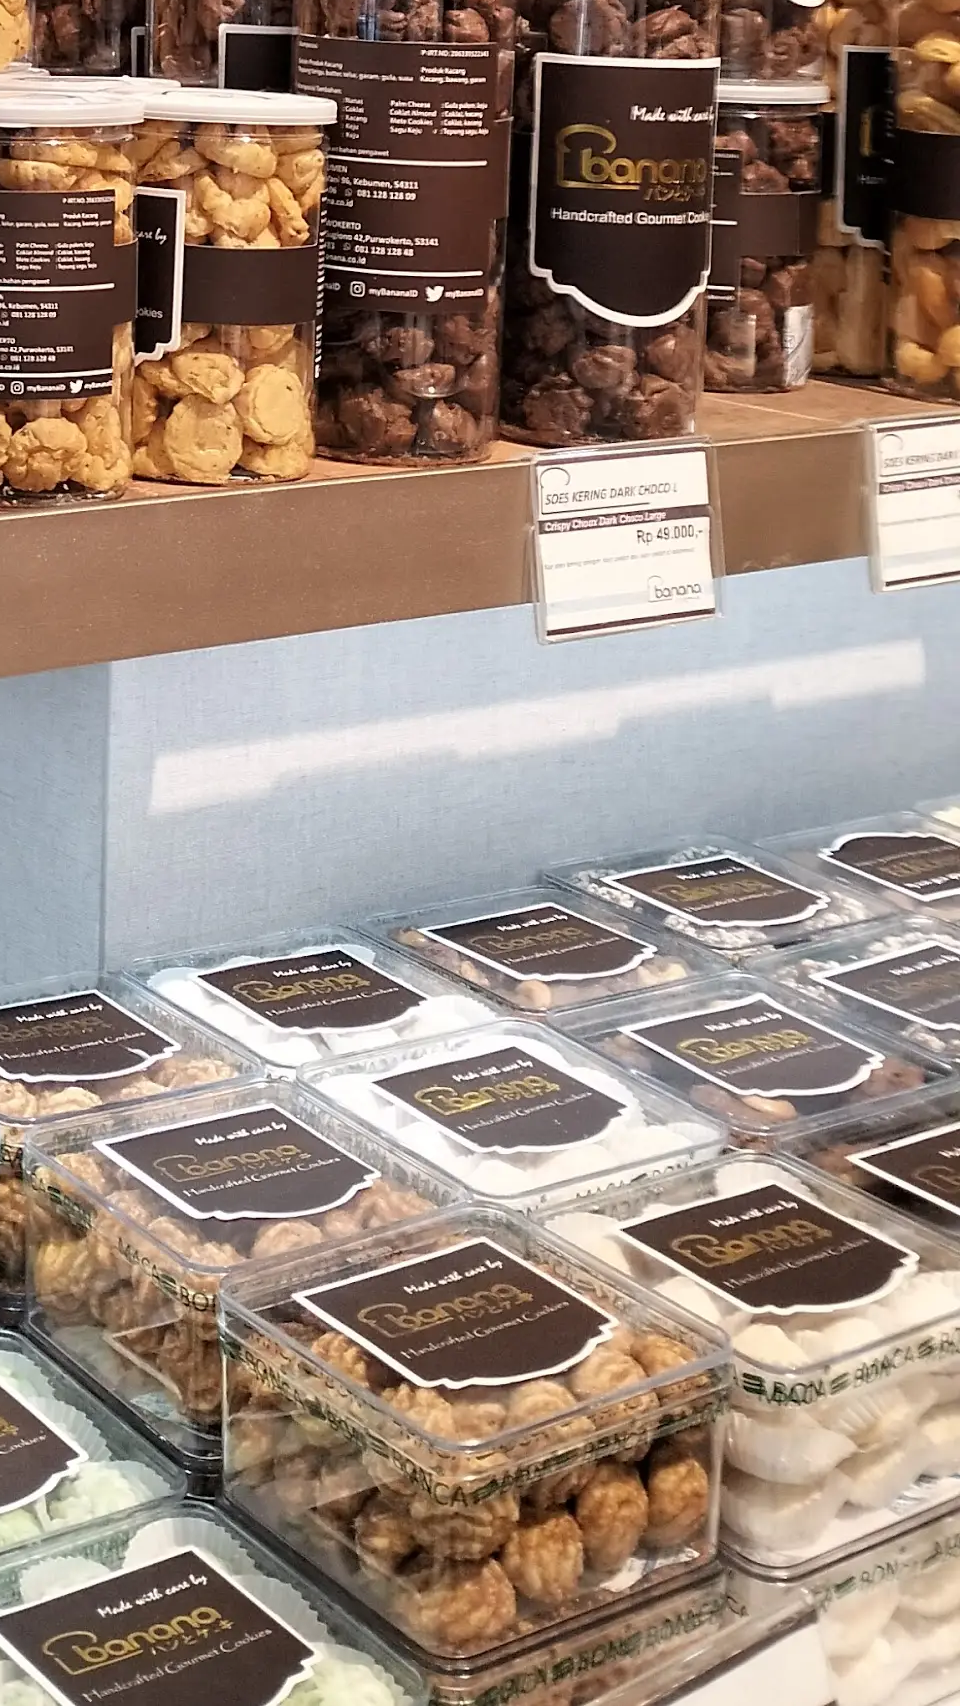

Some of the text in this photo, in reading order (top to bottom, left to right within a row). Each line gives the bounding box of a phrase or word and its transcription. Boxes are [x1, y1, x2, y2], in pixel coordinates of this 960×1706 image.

[630, 105, 692, 123] Made with
[581, 148, 708, 183] banana
[353, 178, 392, 189] Kebumen,
[356, 189, 417, 201] 081 128 128 09
[551, 207, 687, 225] Handcrafted Gourmet
[354, 244, 371, 254] 081
[371, 246, 386, 255] 128
[387, 247, 403, 256] 128
[545, 493, 569, 505] SOES
[572, 488, 607, 503] KERING
[610, 486, 636, 499] DARK
[544, 511, 667, 533] Crispy Choux Dark Choco Large
[637, 524, 703, 545] Rp 49.000,-
[655, 582, 702, 598] banana
[177, 1144, 300, 1176] banana
[389, 1284, 522, 1330] banana
[97, 1573, 208, 1618] Made with care by
[72, 1606, 222, 1664] banana
[82, 1628, 273, 1703] Handcrafted Gourmet Cookies
